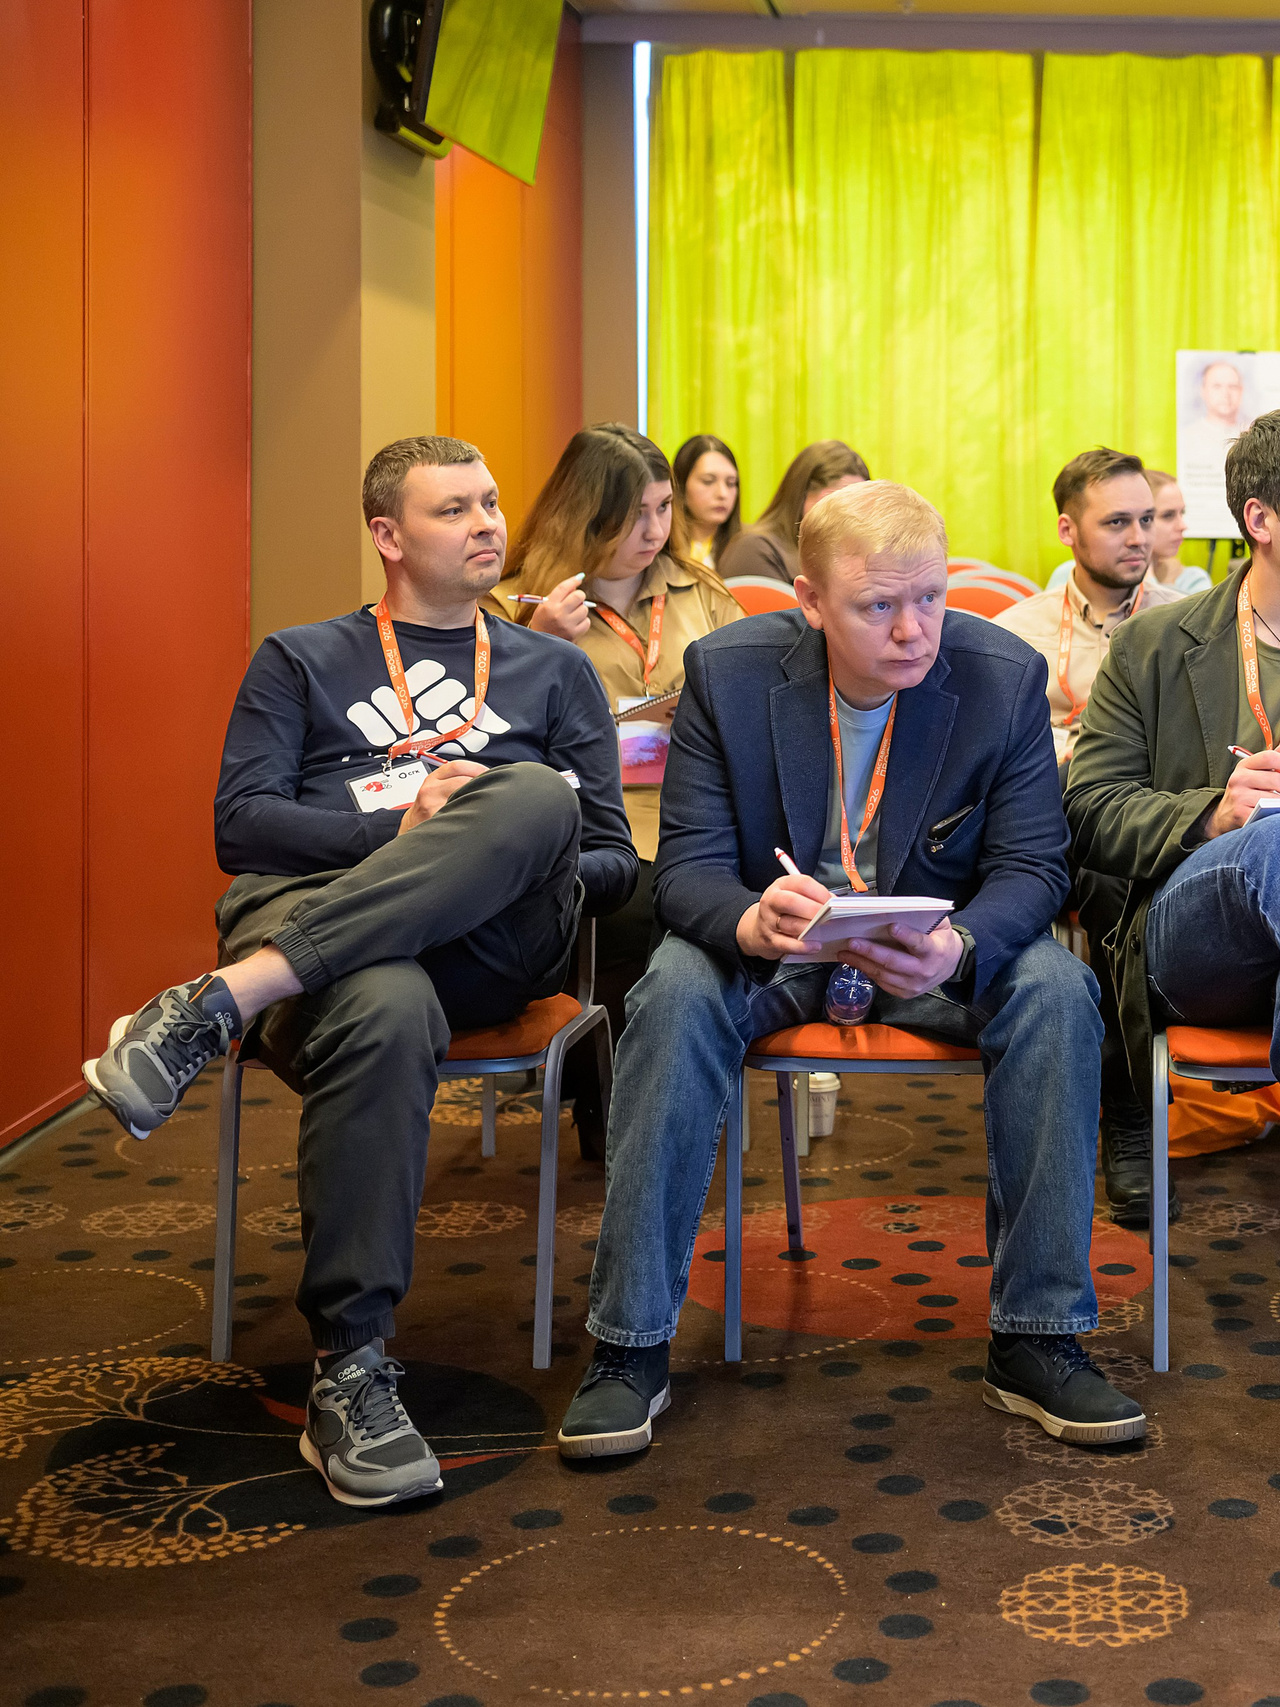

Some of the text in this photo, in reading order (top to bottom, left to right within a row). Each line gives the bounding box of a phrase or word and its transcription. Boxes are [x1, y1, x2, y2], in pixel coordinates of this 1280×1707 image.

[1242, 578, 1250, 611] ПРОФИ
[381, 620, 392, 641] 2026
[608, 615, 626, 634] 2026
[1242, 620, 1253, 649] 2026
[386, 649, 398, 678] ПРОФИ
[478, 650, 487, 674] 2026
[1249, 658, 1258, 693] ПРОФИ
[396, 683, 409, 709] 2026
[1253, 703, 1270, 733] 2026
[876, 738, 888, 776] НАСТАВНИК
[866, 788, 880, 819] 2026
[842, 833, 851, 872] ПРОФИ
